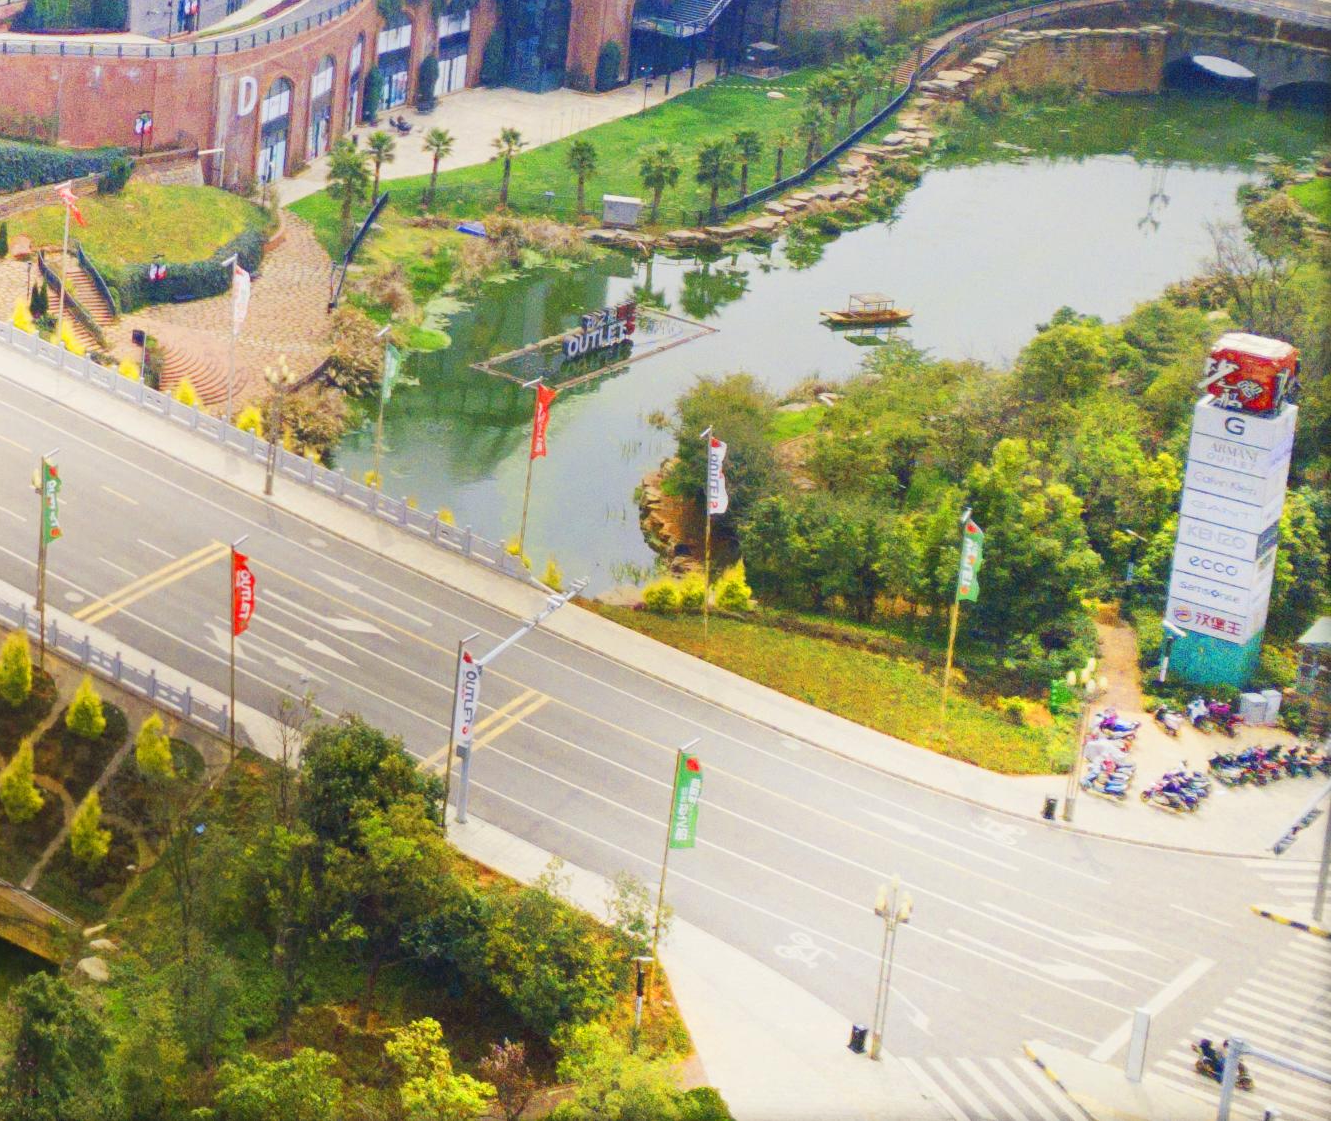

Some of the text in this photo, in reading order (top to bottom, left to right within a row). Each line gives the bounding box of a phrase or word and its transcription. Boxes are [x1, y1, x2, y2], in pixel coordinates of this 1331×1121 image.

[237, 75, 258, 117] D
[1225, 416, 1246, 436] G
[1212, 442, 1259, 463] ARMANI
[1187, 524, 1247, 550] KENZO
[1189, 555, 1238, 576] ecco
[1195, 611, 1242, 636] 汉堡王
